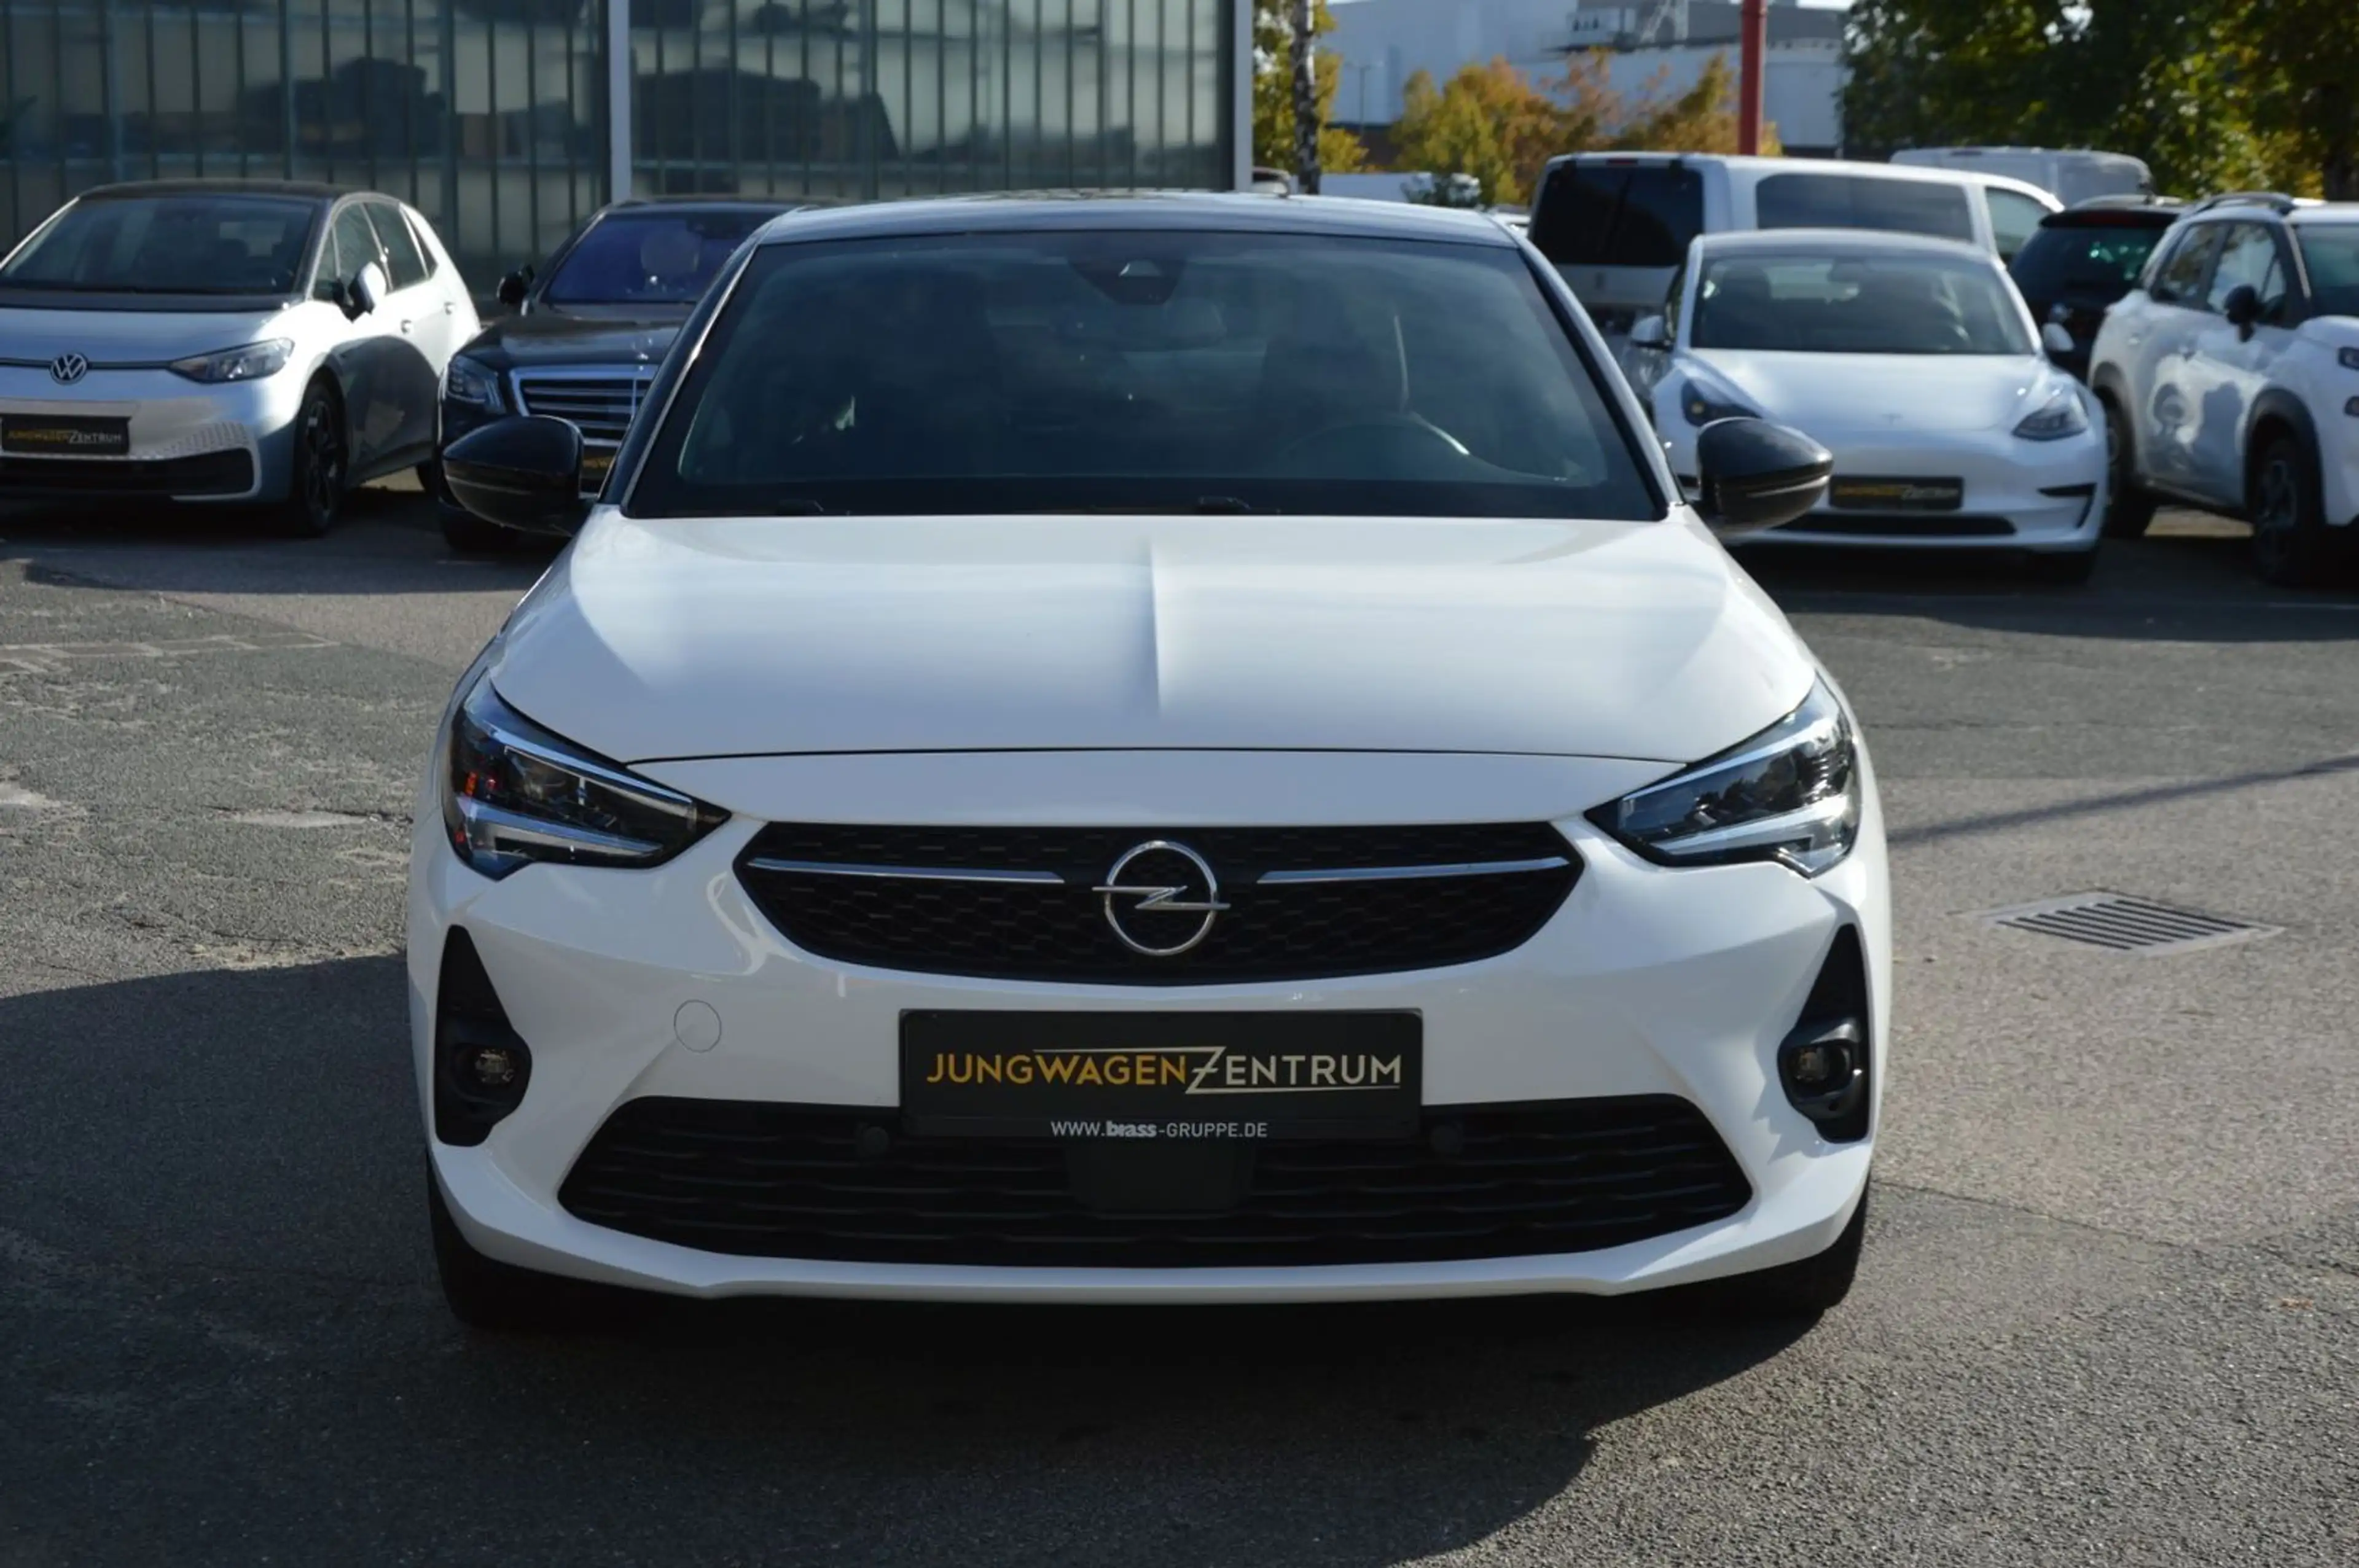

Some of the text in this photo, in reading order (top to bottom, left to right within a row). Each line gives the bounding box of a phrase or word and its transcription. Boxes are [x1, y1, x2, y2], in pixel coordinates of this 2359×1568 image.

[52, 353, 86, 380] VW
[926, 1046, 1402, 1094] JUNGWAGENZENTRUM
[1050, 1120, 1269, 1138] WWW.brass-GRUPPE.DE
